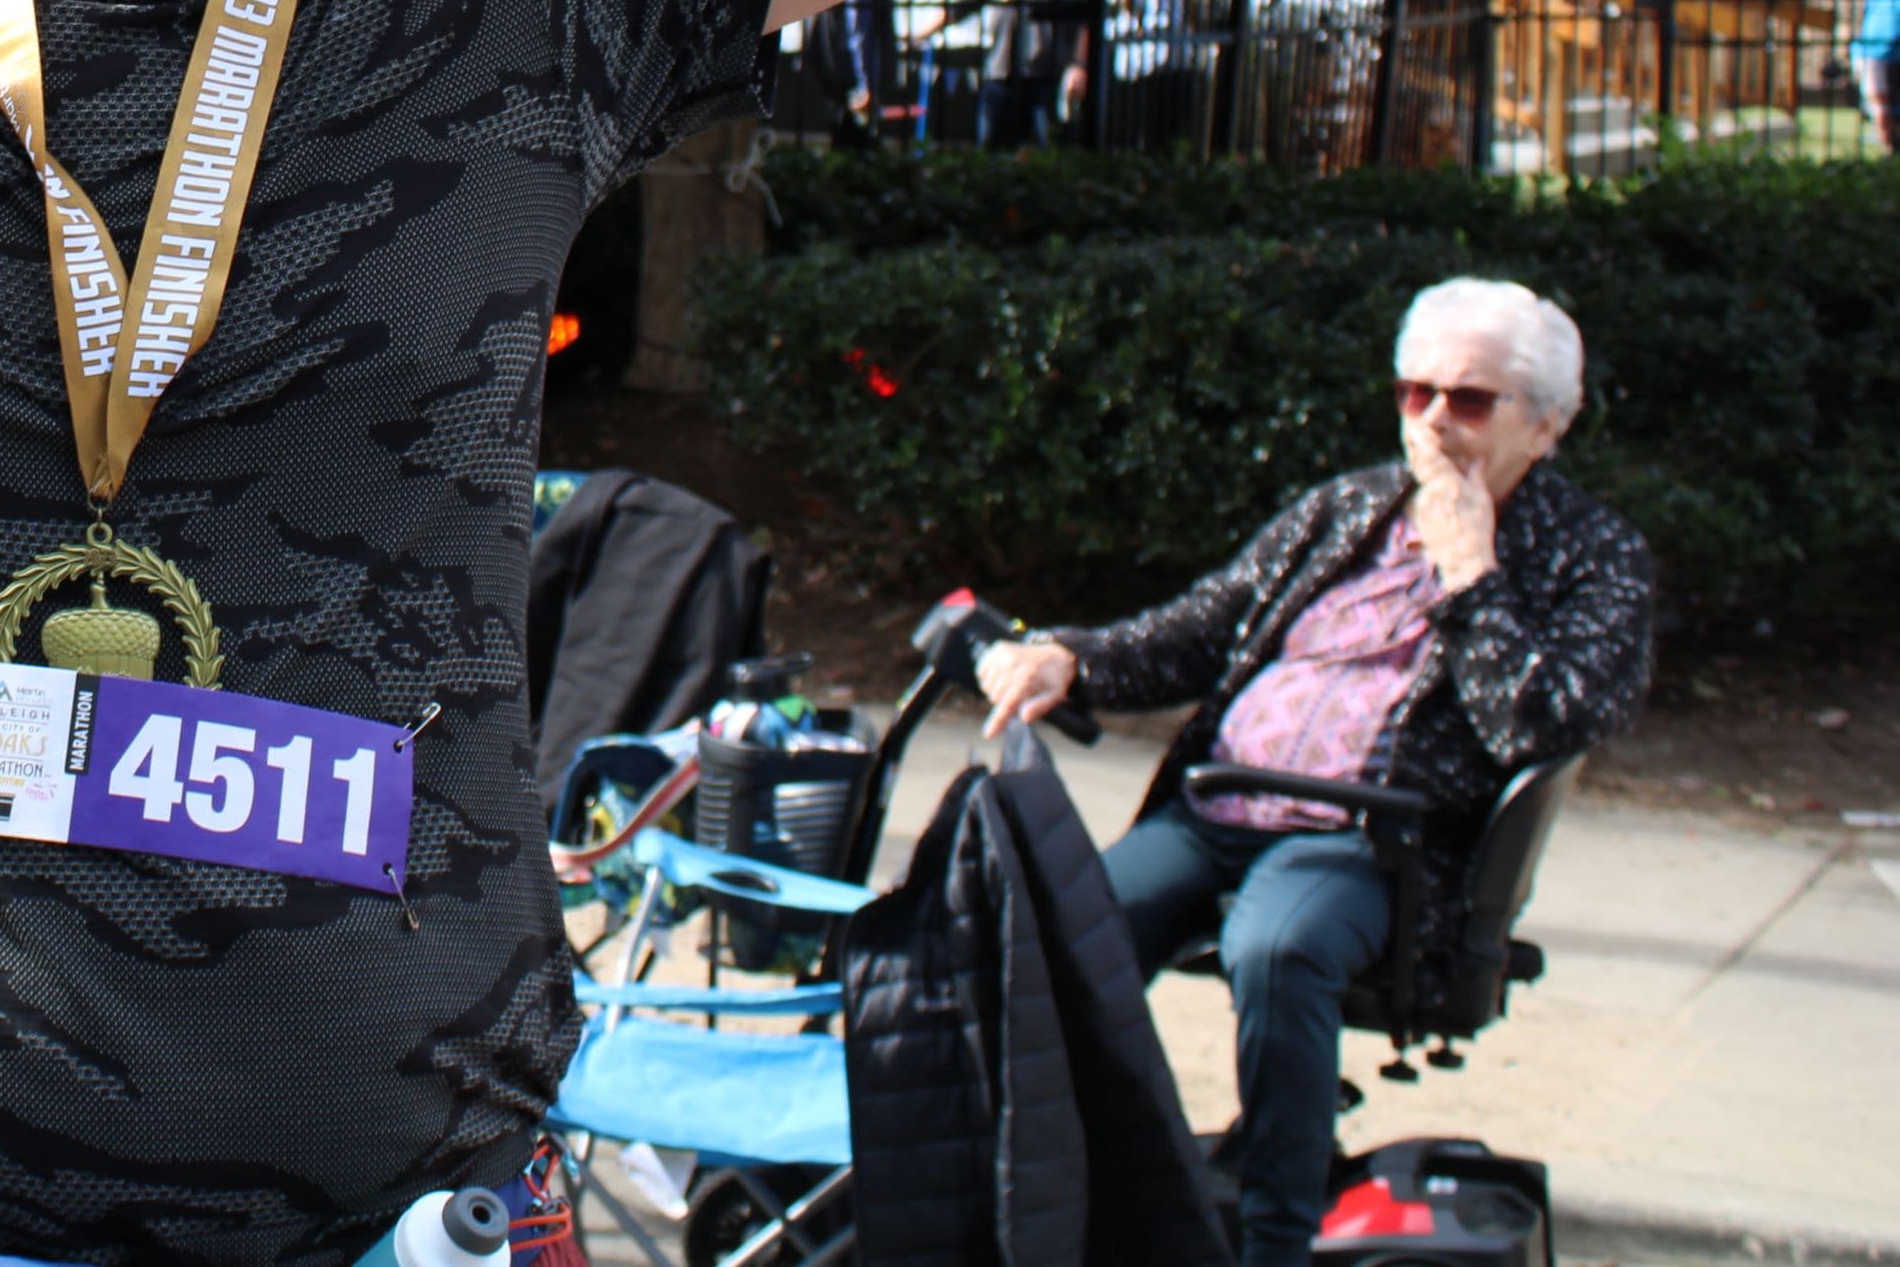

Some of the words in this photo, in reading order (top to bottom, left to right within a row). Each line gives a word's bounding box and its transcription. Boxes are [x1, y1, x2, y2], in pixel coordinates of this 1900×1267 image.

[166, 25, 267, 226] MARATHON
[56, 205, 124, 377] FINISHER
[127, 234, 216, 397] FINISHER
[69, 691, 94, 771] MARATHON
[108, 714, 376, 856] 4511
